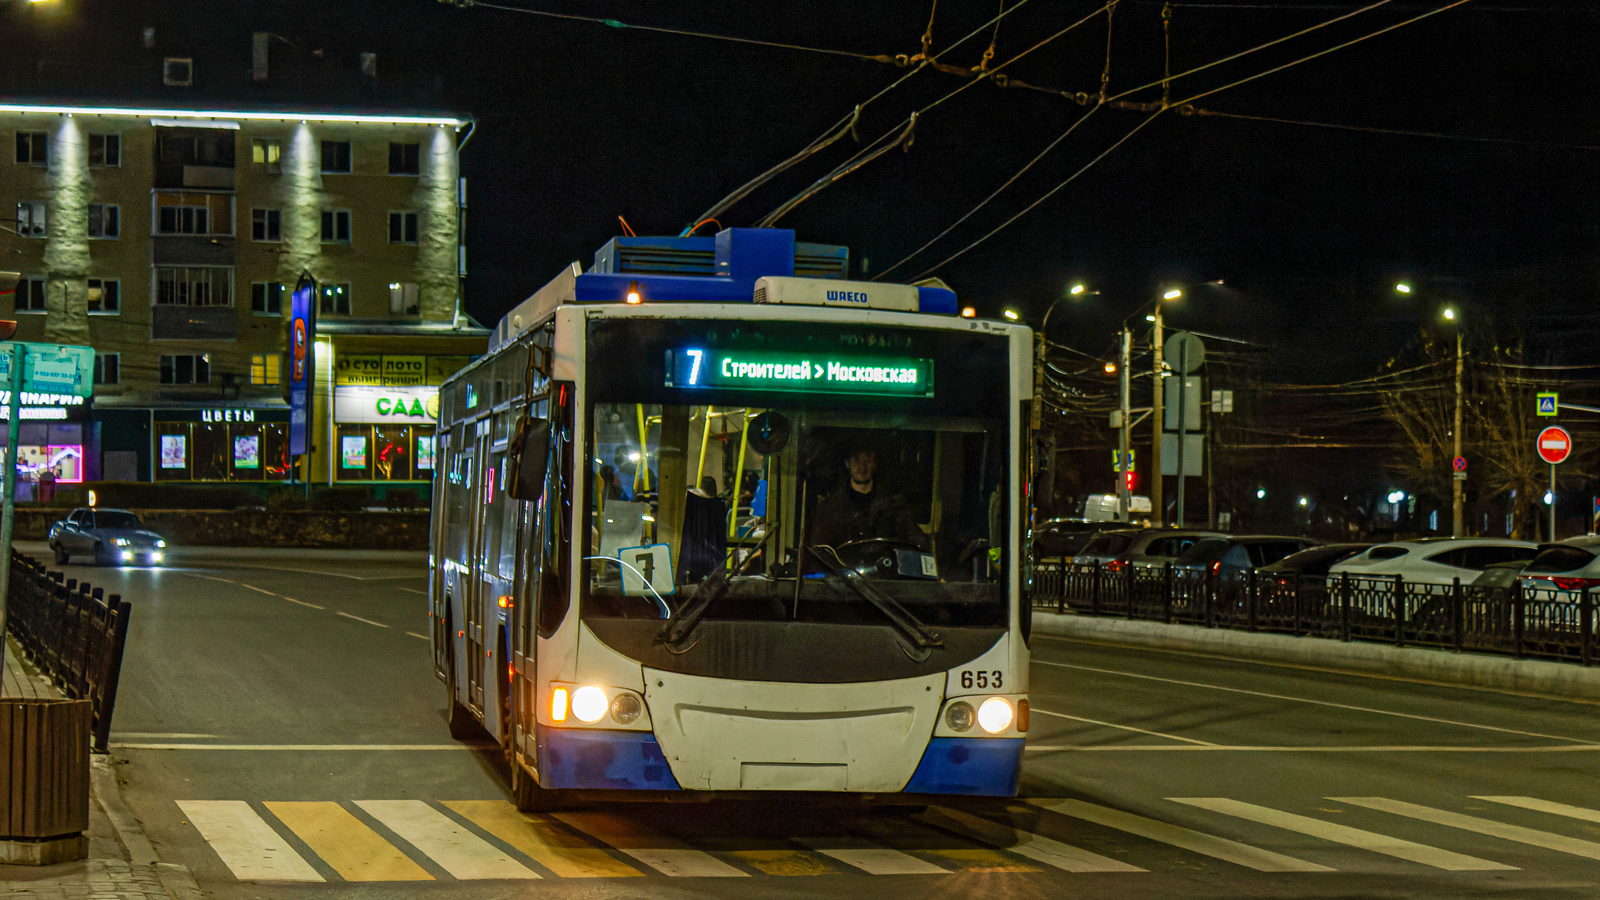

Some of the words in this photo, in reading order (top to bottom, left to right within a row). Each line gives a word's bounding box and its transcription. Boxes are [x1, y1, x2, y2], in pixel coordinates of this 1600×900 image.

[826, 290, 868, 304] WAECO
[686, 349, 703, 385] 7
[721, 357, 811, 380] Строителей
[827, 361, 918, 384] Московская
[201, 409, 255, 423] ЦВЕТЫ
[635, 552, 654, 590] 7
[960, 669, 1003, 689] 653
